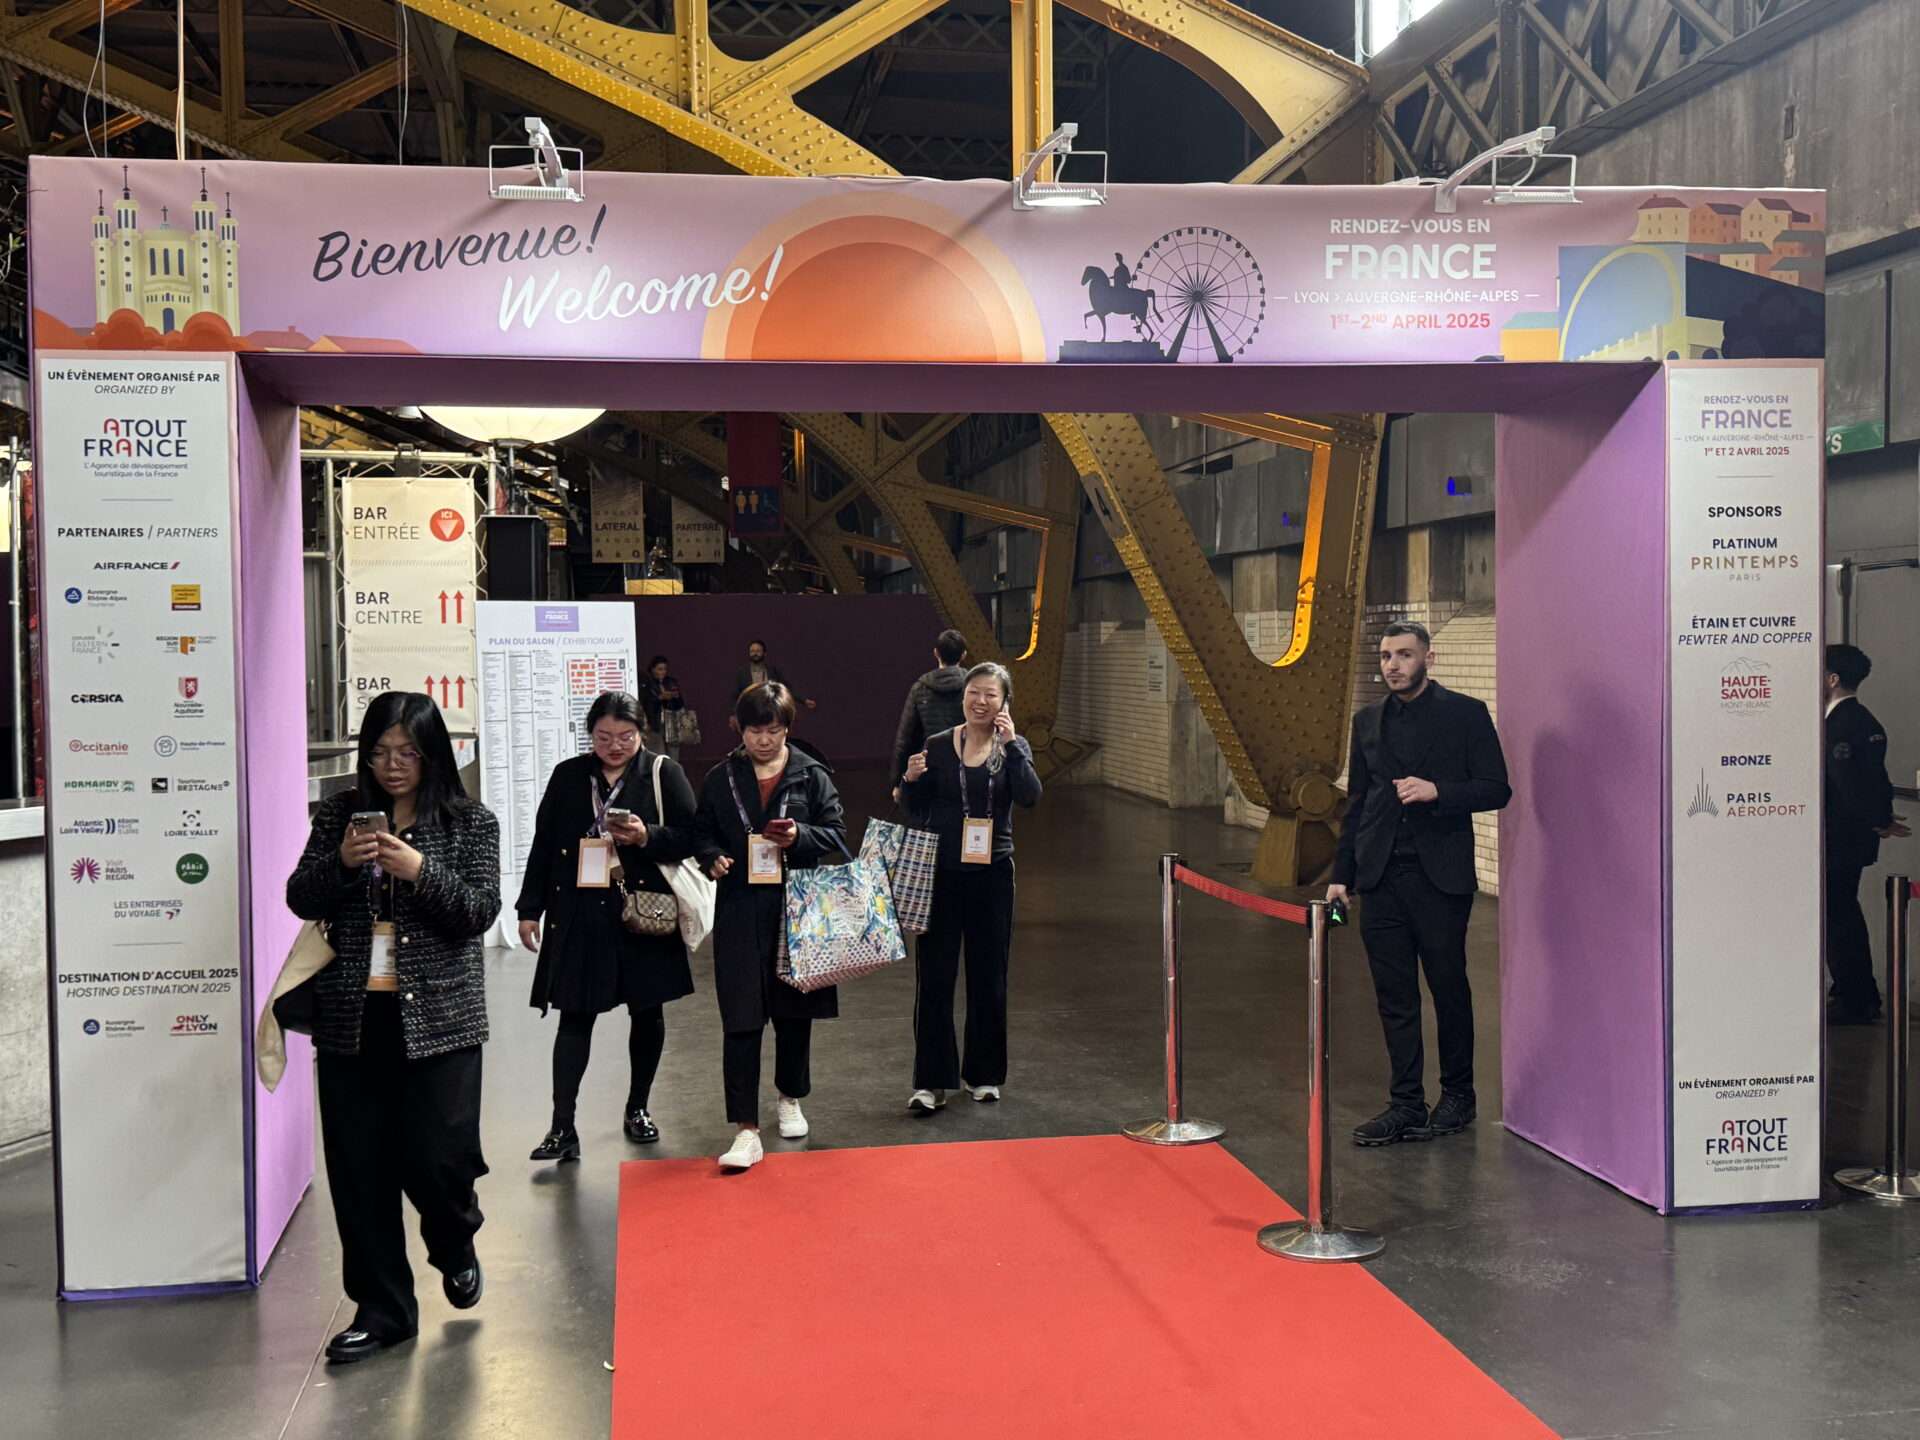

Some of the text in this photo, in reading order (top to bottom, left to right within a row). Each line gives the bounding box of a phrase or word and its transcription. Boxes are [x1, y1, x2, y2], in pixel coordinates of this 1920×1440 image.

[1330, 219, 1490, 234] RENDEZ-VOUS EN
[313, 204, 607, 282] Bienvenue!
[1325, 243, 1496, 280] FRANCE
[499, 244, 784, 331] Welcome!
[1295, 291, 1329, 304] LYON
[1346, 287, 1519, 303] AUVERGNE-RHÔNE-ALPES
[1392, 314, 1442, 329] APRIL
[1446, 313, 1490, 328] 2025
[47, 369, 220, 382] UN ÉVÈNEMENT ORGANISÉ PAR
[94, 385, 176, 395] ORGANIZED BY
[1704, 395, 1789, 404] RENDEZ-VOUS EN
[1701, 409, 1792, 429] FRANCE
[103, 418, 187, 437] ATOUT
[1684, 434, 1704, 442] LYON
[84, 438, 188, 457] FRANCE
[1715, 448, 1726, 456] ET
[1728, 448, 1734, 456] 2
[1736, 447, 1764, 456] AVRIL
[1766, 447, 1789, 455] 2025
[353, 507, 387, 520] BAR
[1708, 506, 1782, 518] SPONSORS
[57, 527, 144, 537] PARTENAIRES
[156, 527, 218, 537] PARTNERS
[353, 523, 420, 540] ENTRÉE
[1712, 537, 1777, 549] PLATINUM
[1691, 555, 1799, 570] PRINTEMPS
[1729, 573, 1761, 582] PARIS
[355, 591, 389, 604] BAR
[355, 610, 423, 624] CENTRE
[1692, 616, 1796, 629] ÉTAIN ET CUIVRE
[489, 637, 511, 645] PLAN
[512, 637, 525, 645] DU
[526, 637, 555, 645] SALON
[1678, 632, 1812, 646] PEWTER AND COPPER
[356, 677, 391, 690] BAR
[1721, 675, 1771, 688] HAUTE-
[1721, 687, 1771, 699] SAVOIE
[69, 739, 129, 752] Occitanie
[1721, 755, 1772, 766] BRONZE
[1727, 792, 1772, 803] PARIS
[1727, 804, 1806, 817] AÉROPORT
[114, 900, 183, 909] LES ENTREPRISES
[114, 909, 161, 918] DU VOYAGE
[59, 968, 238, 983] DESTINATION D'ACCUEIL 2025
[66, 982, 231, 998] HOSTING DESTINATION 2025
[176, 1014, 209, 1024] ONLY
[186, 1023, 218, 1032] LYON
[1679, 1074, 1815, 1090] UN ÉVÈNEMENT ORGANISÉ PAR
[1715, 1088, 1780, 1100] ORGANIZED BY
[1722, 1118, 1788, 1136] ATOUT
[1706, 1135, 1788, 1155] FRANCE
